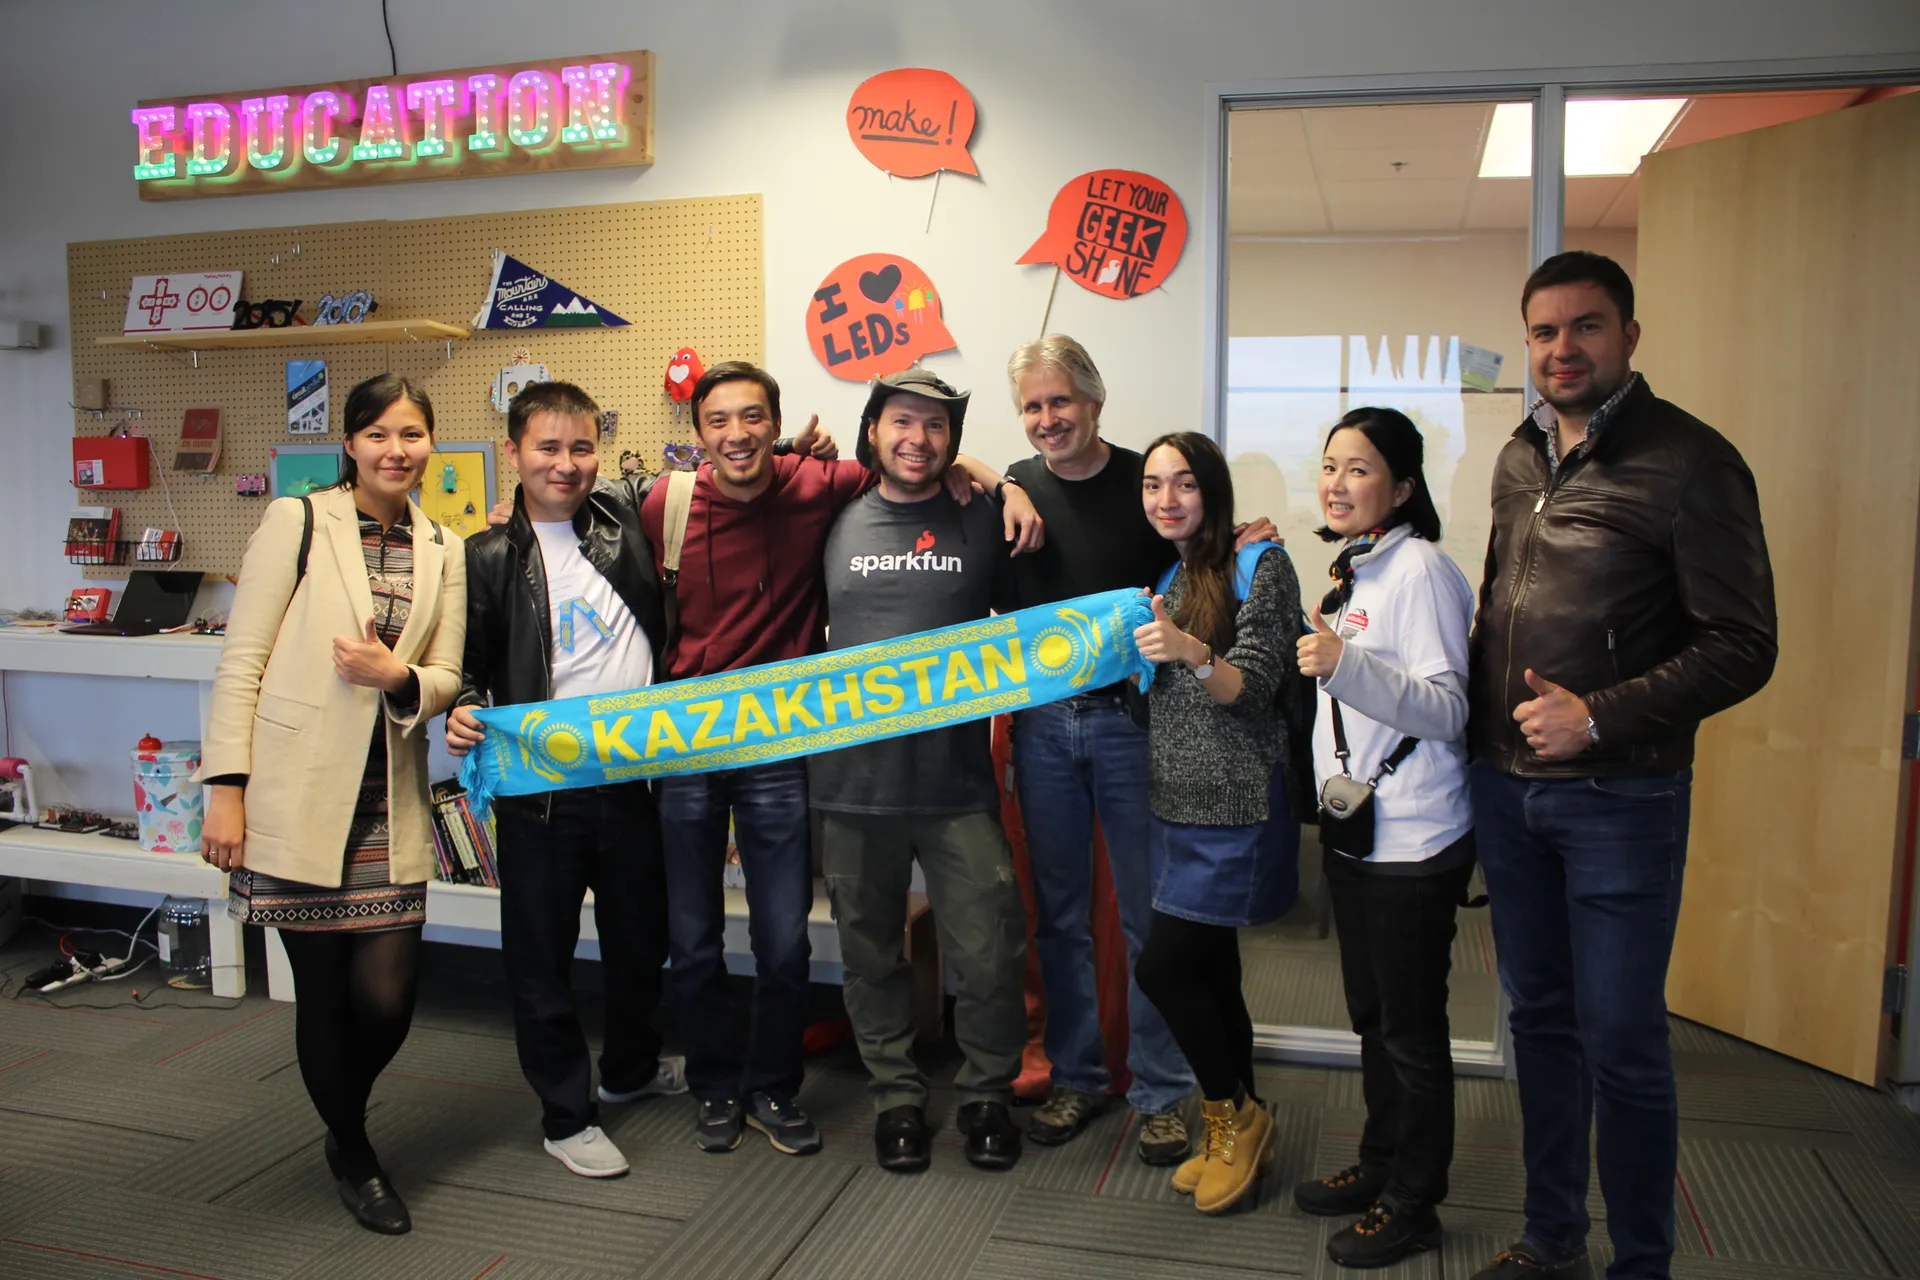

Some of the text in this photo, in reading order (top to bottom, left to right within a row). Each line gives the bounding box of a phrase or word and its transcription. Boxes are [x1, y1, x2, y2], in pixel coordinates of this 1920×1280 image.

[132, 62, 625, 181] EDUCATION
[852, 99, 957, 145] make!
[1087, 176, 1169, 217] LET YOUR
[1081, 203, 1162, 260] GEEK
[500, 304, 543, 312] CALLING
[523, 294, 538, 302] ARE
[814, 282, 848, 324] I
[823, 313, 910, 366] LEDs
[850, 551, 962, 578] sparkfun
[592, 637, 1028, 763] KAZAKHSTAN
